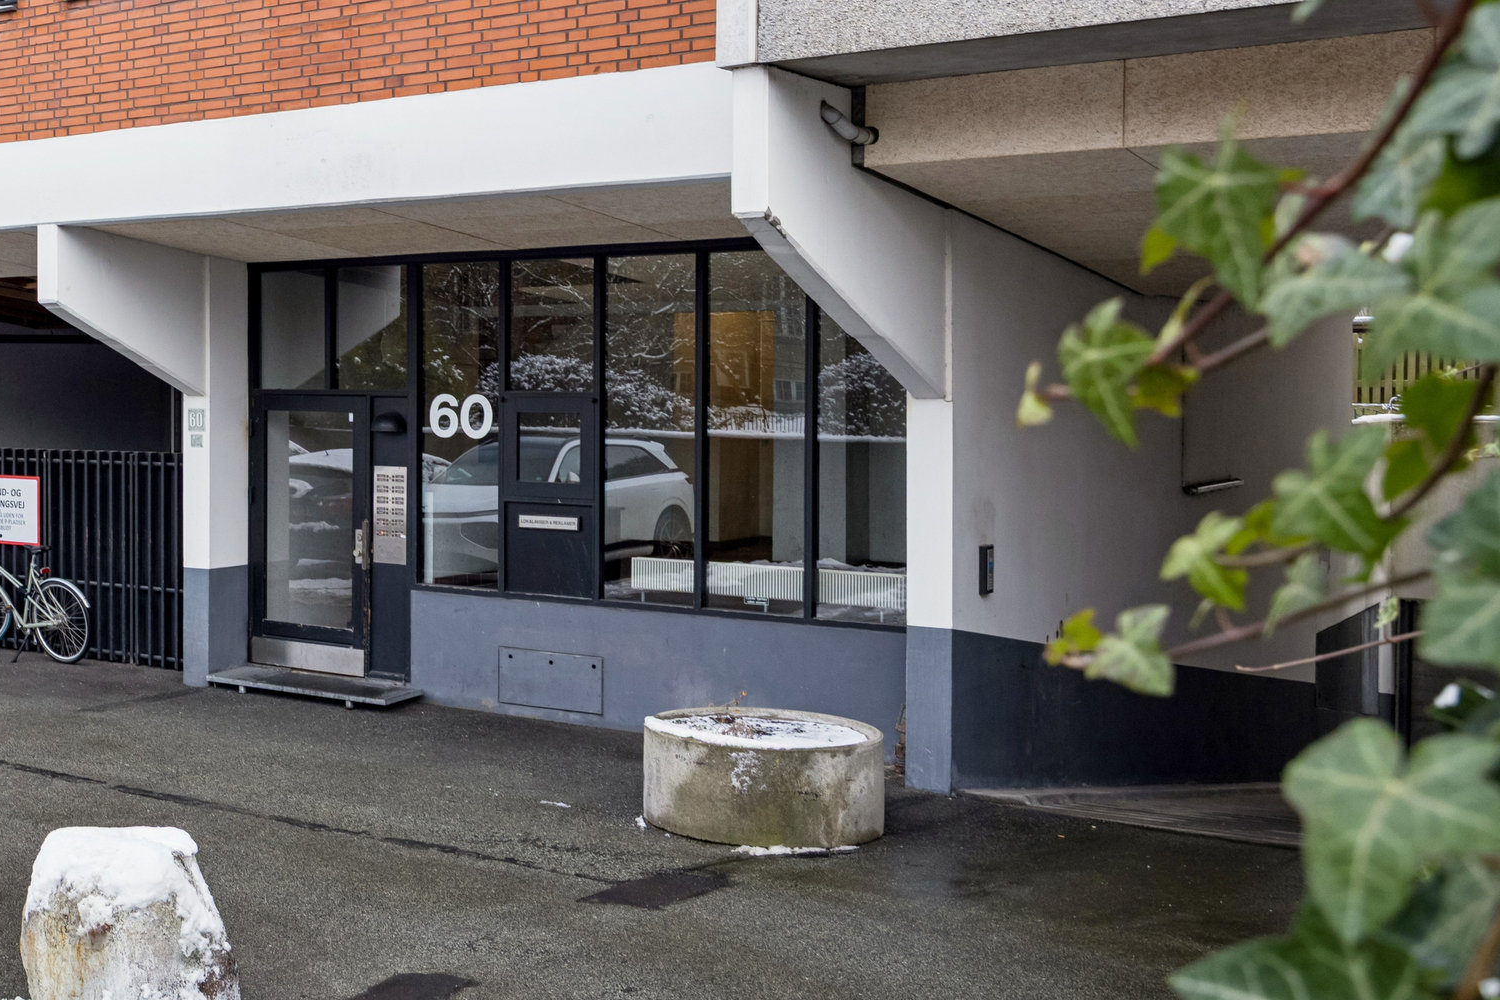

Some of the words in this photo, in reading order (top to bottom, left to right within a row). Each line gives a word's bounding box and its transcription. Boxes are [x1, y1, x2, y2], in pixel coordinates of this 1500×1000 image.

[190, 412, 203, 427] 60
[429, 393, 493, 439] 60
[11, 489, 22, 497] OG
